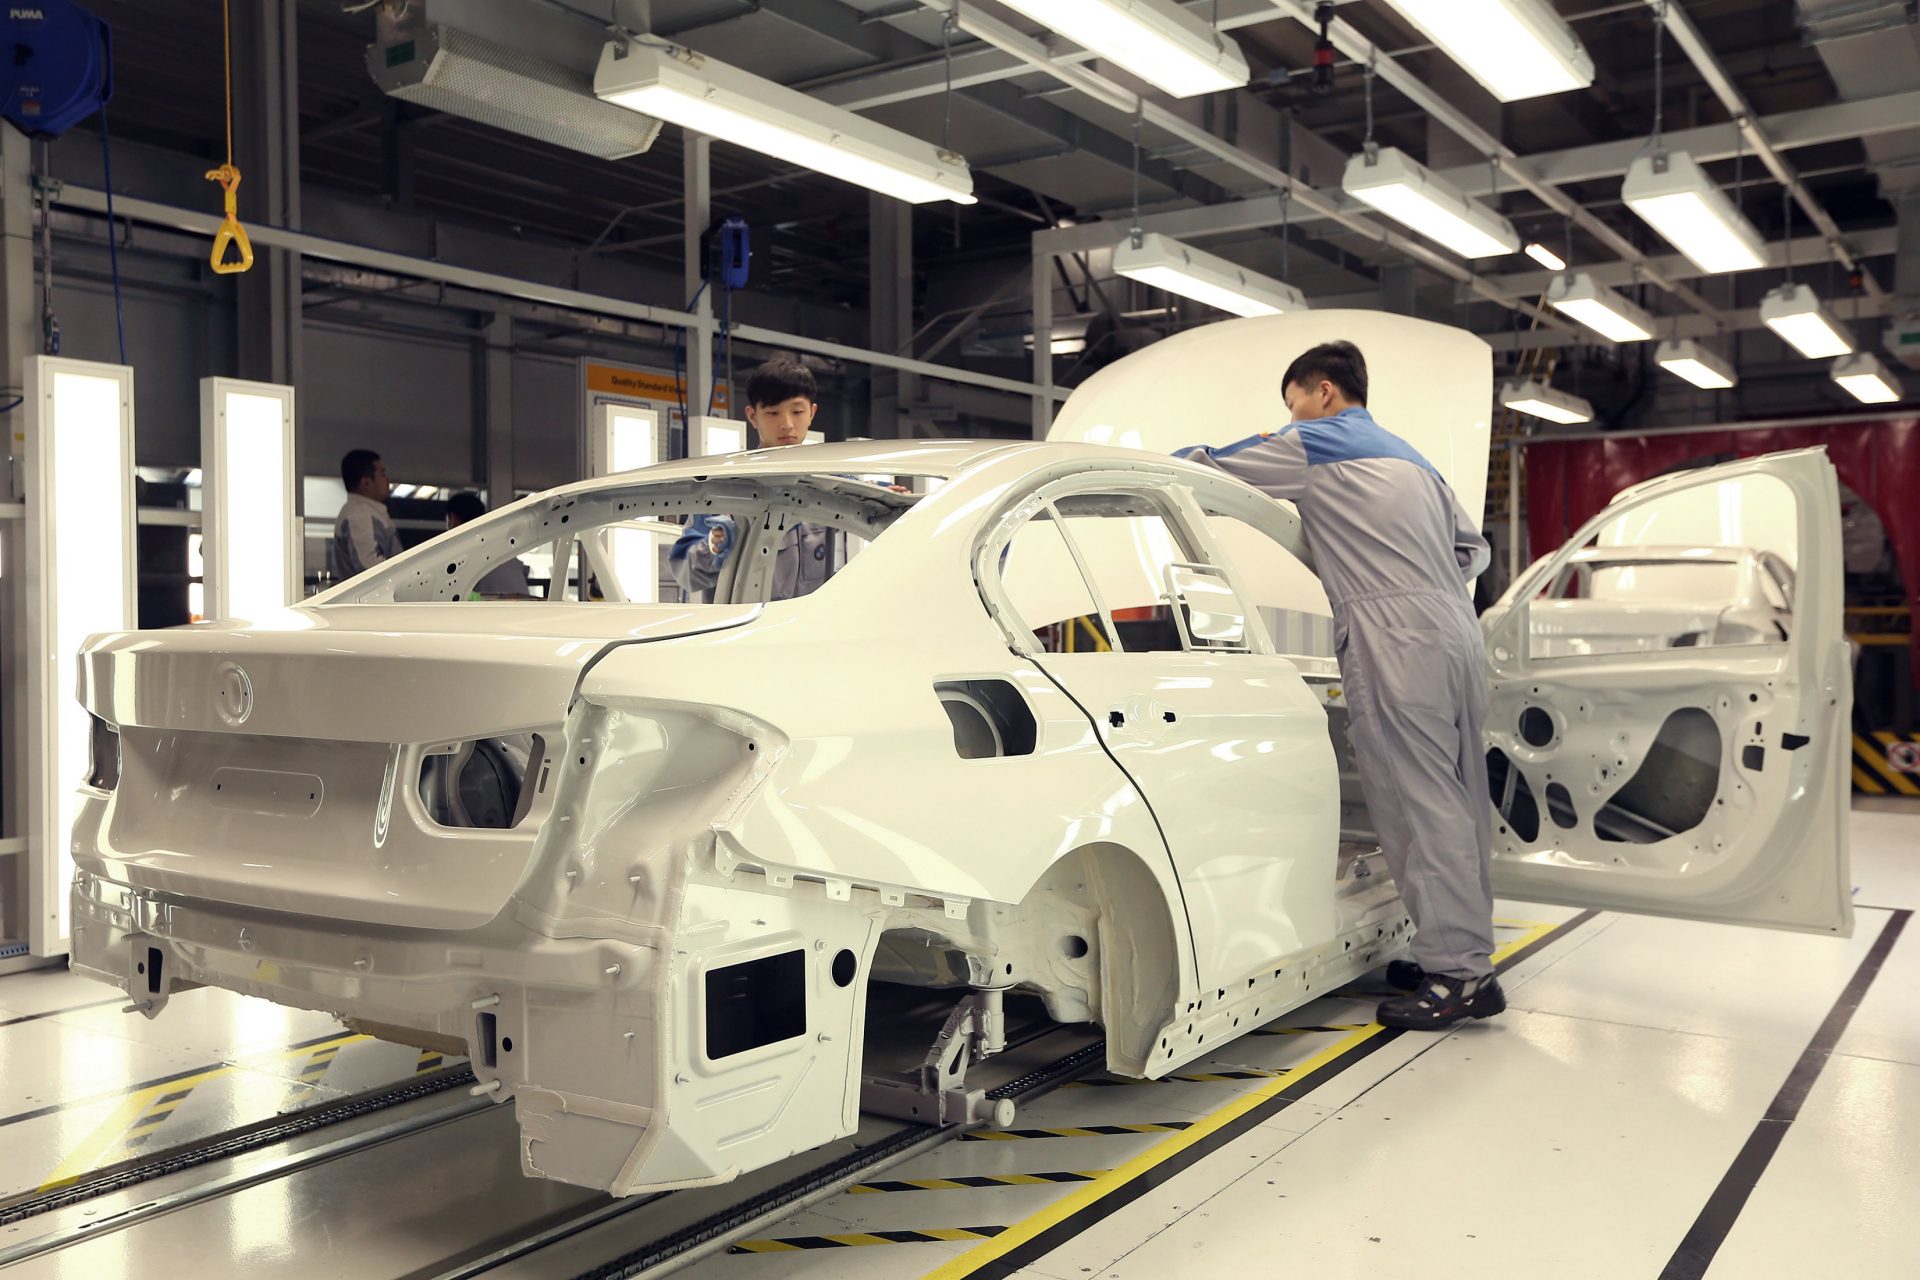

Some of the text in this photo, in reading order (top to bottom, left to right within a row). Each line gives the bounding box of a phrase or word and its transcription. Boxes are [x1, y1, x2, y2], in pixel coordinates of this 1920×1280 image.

[10, 8, 43, 19] PUMA
[611, 376, 636, 389] Quality
[637, 380, 668, 392] Standard
